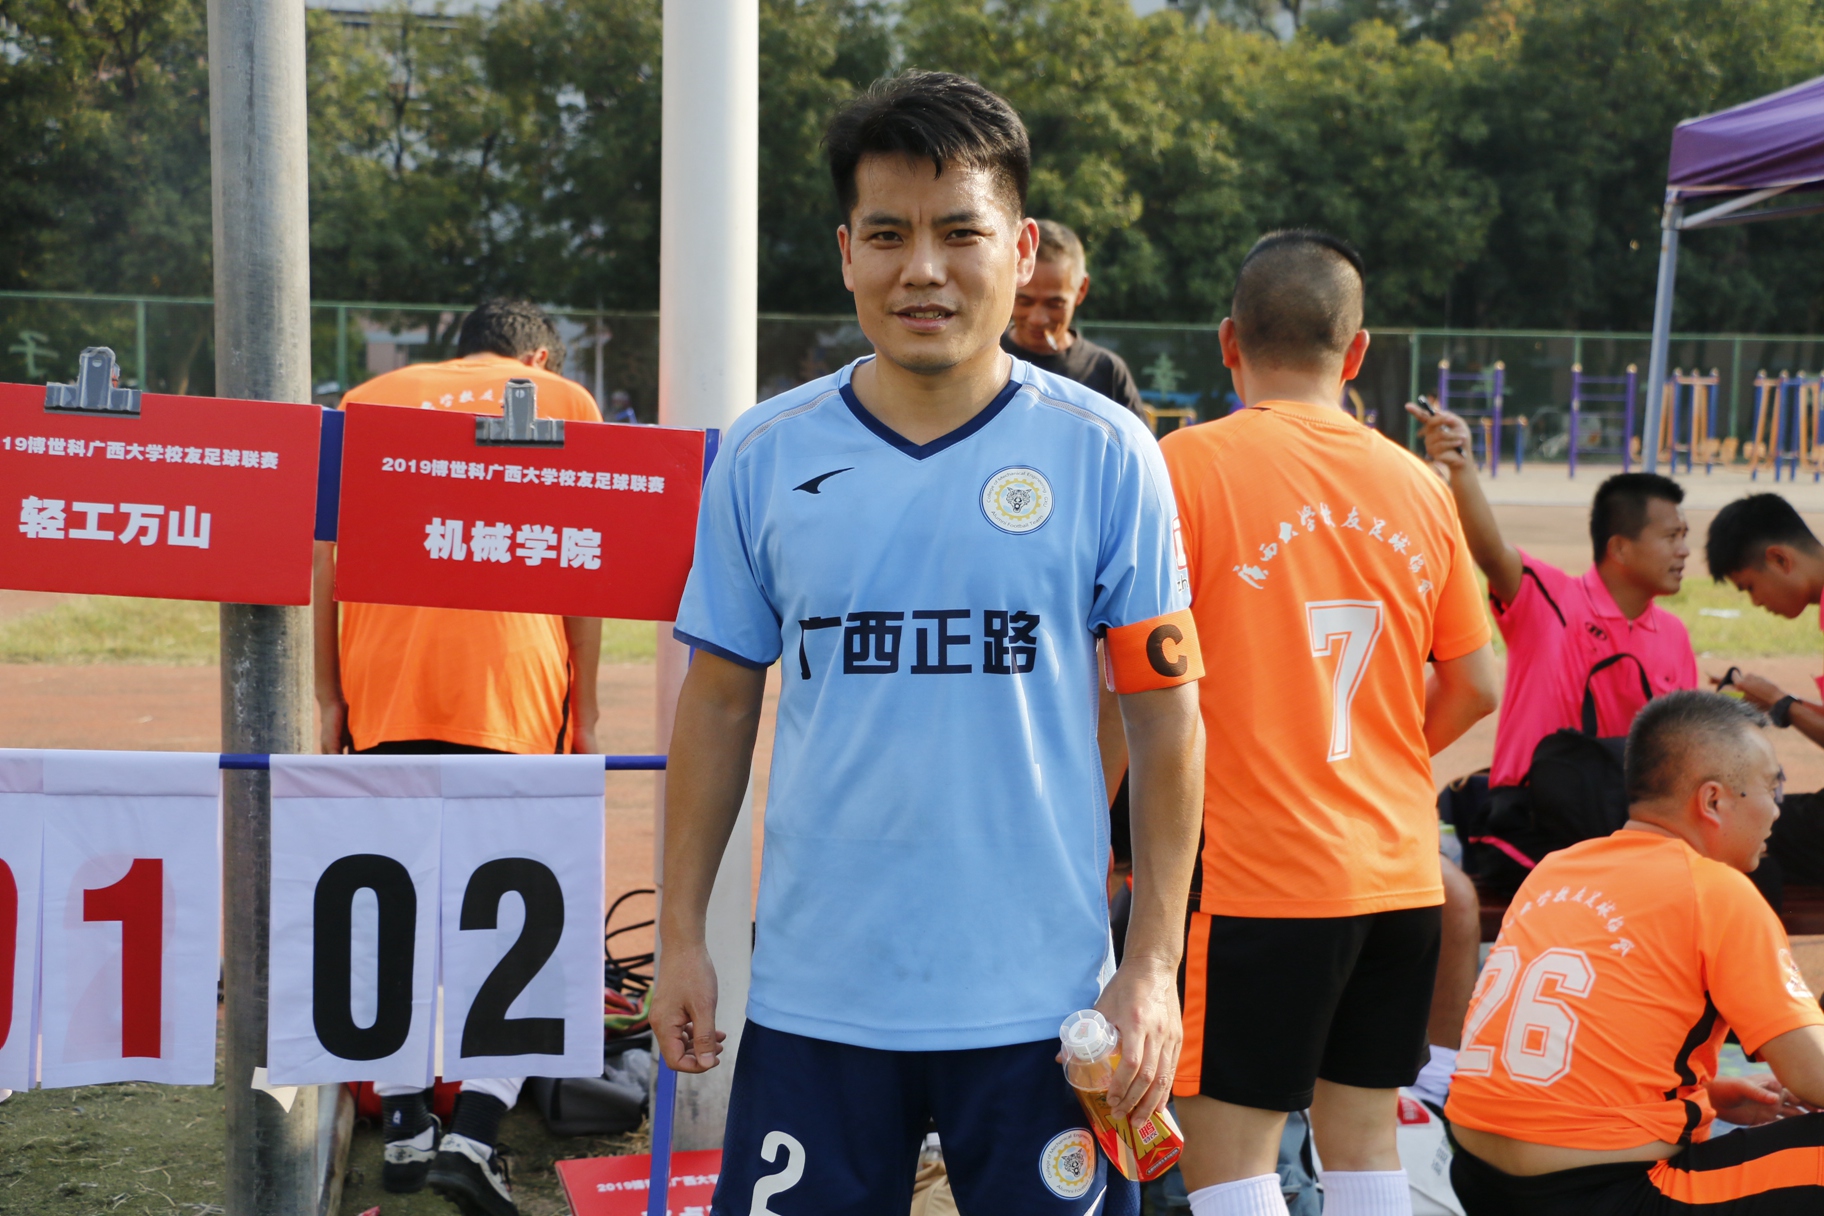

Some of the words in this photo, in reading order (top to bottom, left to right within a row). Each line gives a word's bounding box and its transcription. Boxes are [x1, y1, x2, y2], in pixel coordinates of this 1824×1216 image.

[381, 457, 665, 494] 2019博世科广西大学校友足球联赛
[18, 495, 212, 550] 轻工万山
[423, 516, 602, 570] 机械学院
[798, 608, 1041, 680] 广西正路
[1146, 623, 1188, 678] C
[1305, 599, 1383, 763] 7
[1455, 945, 1596, 1087] 26
[749, 1131, 806, 1216] 2
